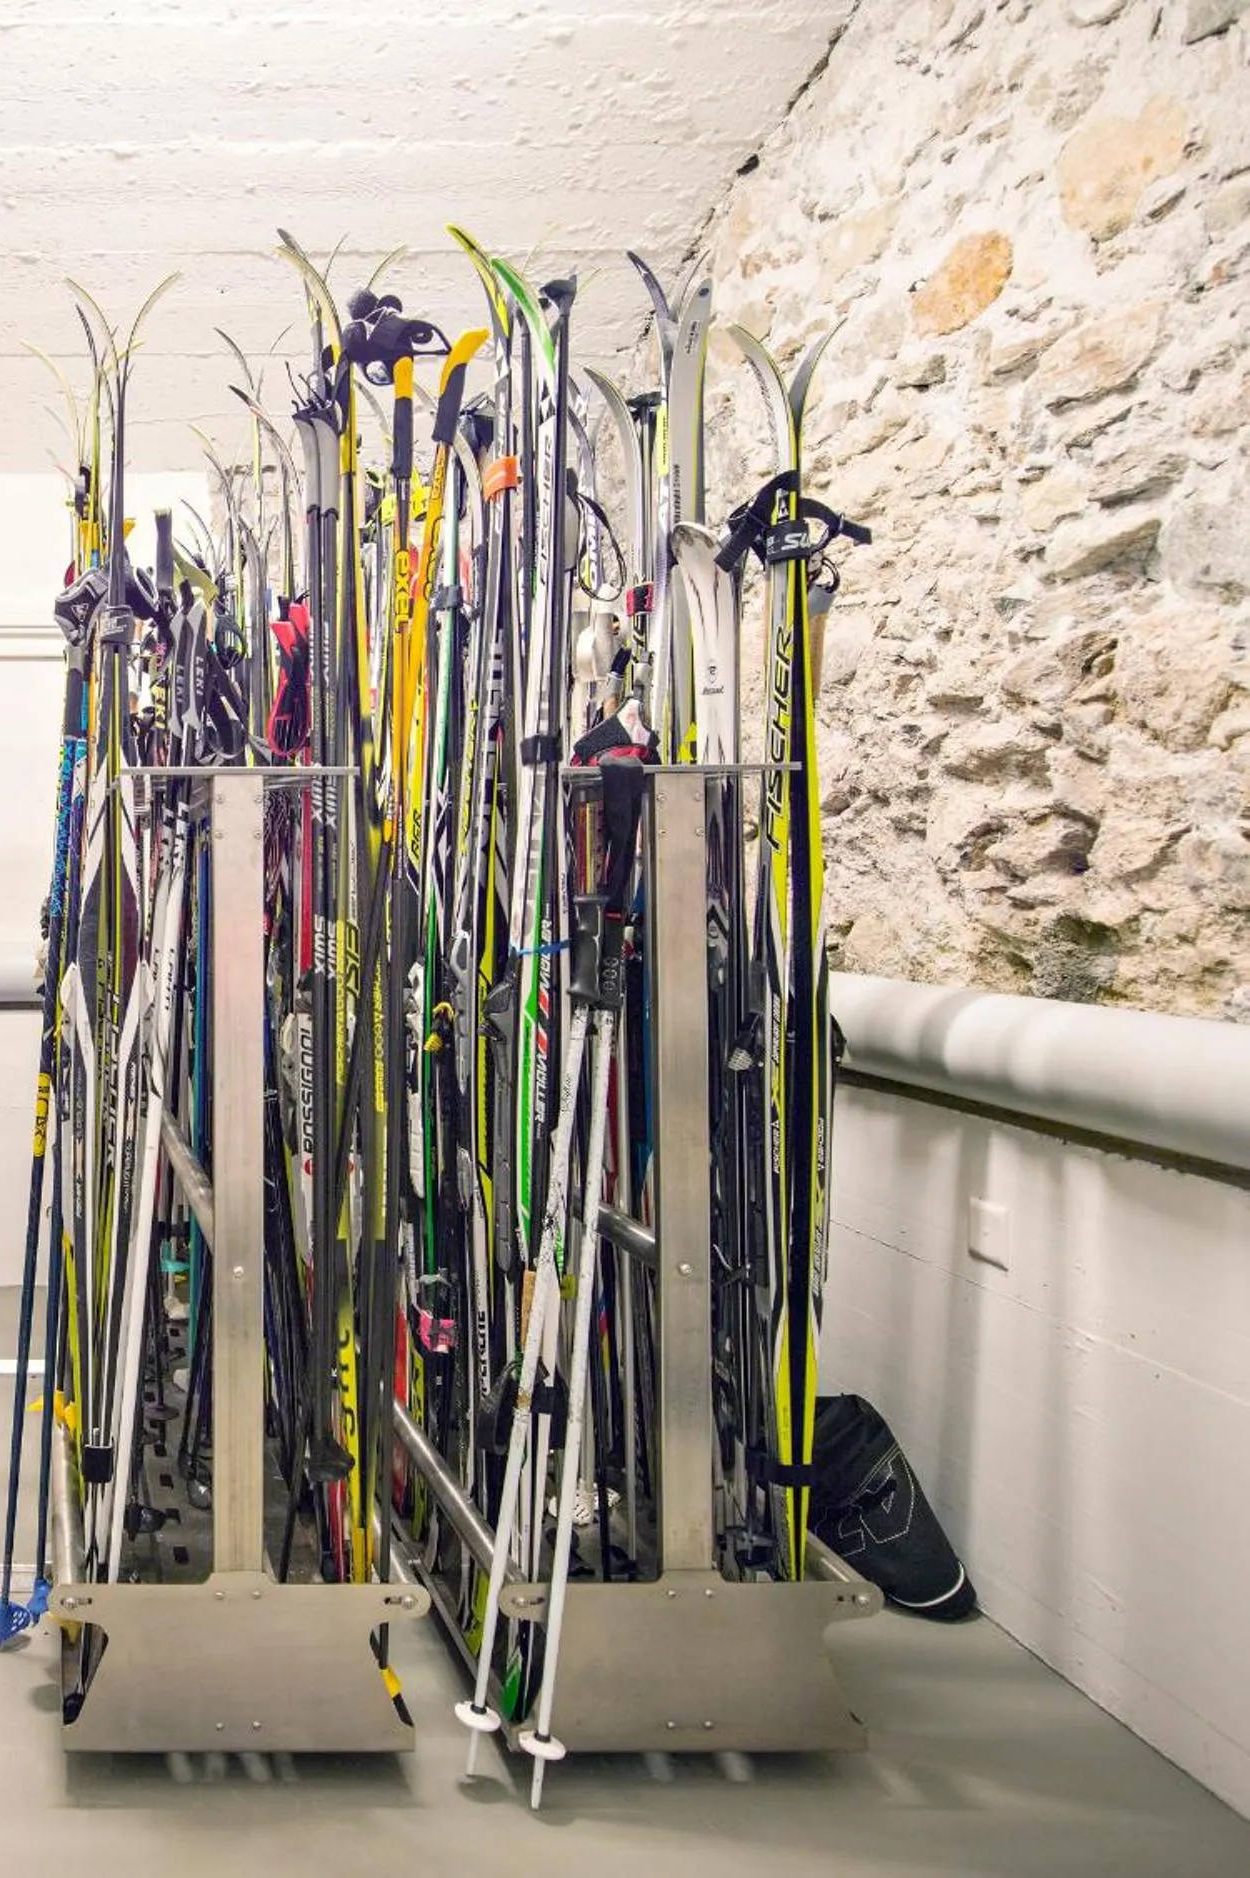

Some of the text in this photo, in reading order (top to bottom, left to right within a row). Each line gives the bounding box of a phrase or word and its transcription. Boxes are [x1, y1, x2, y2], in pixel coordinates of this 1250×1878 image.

[175, 665, 185, 704] LEKI
[194, 656, 205, 698] LEKI
[765, 624, 792, 851] FISCHER
[314, 914, 326, 974] SWIX
[325, 920, 336, 979] SWIX
[772, 1128, 780, 1174] FISCHER
